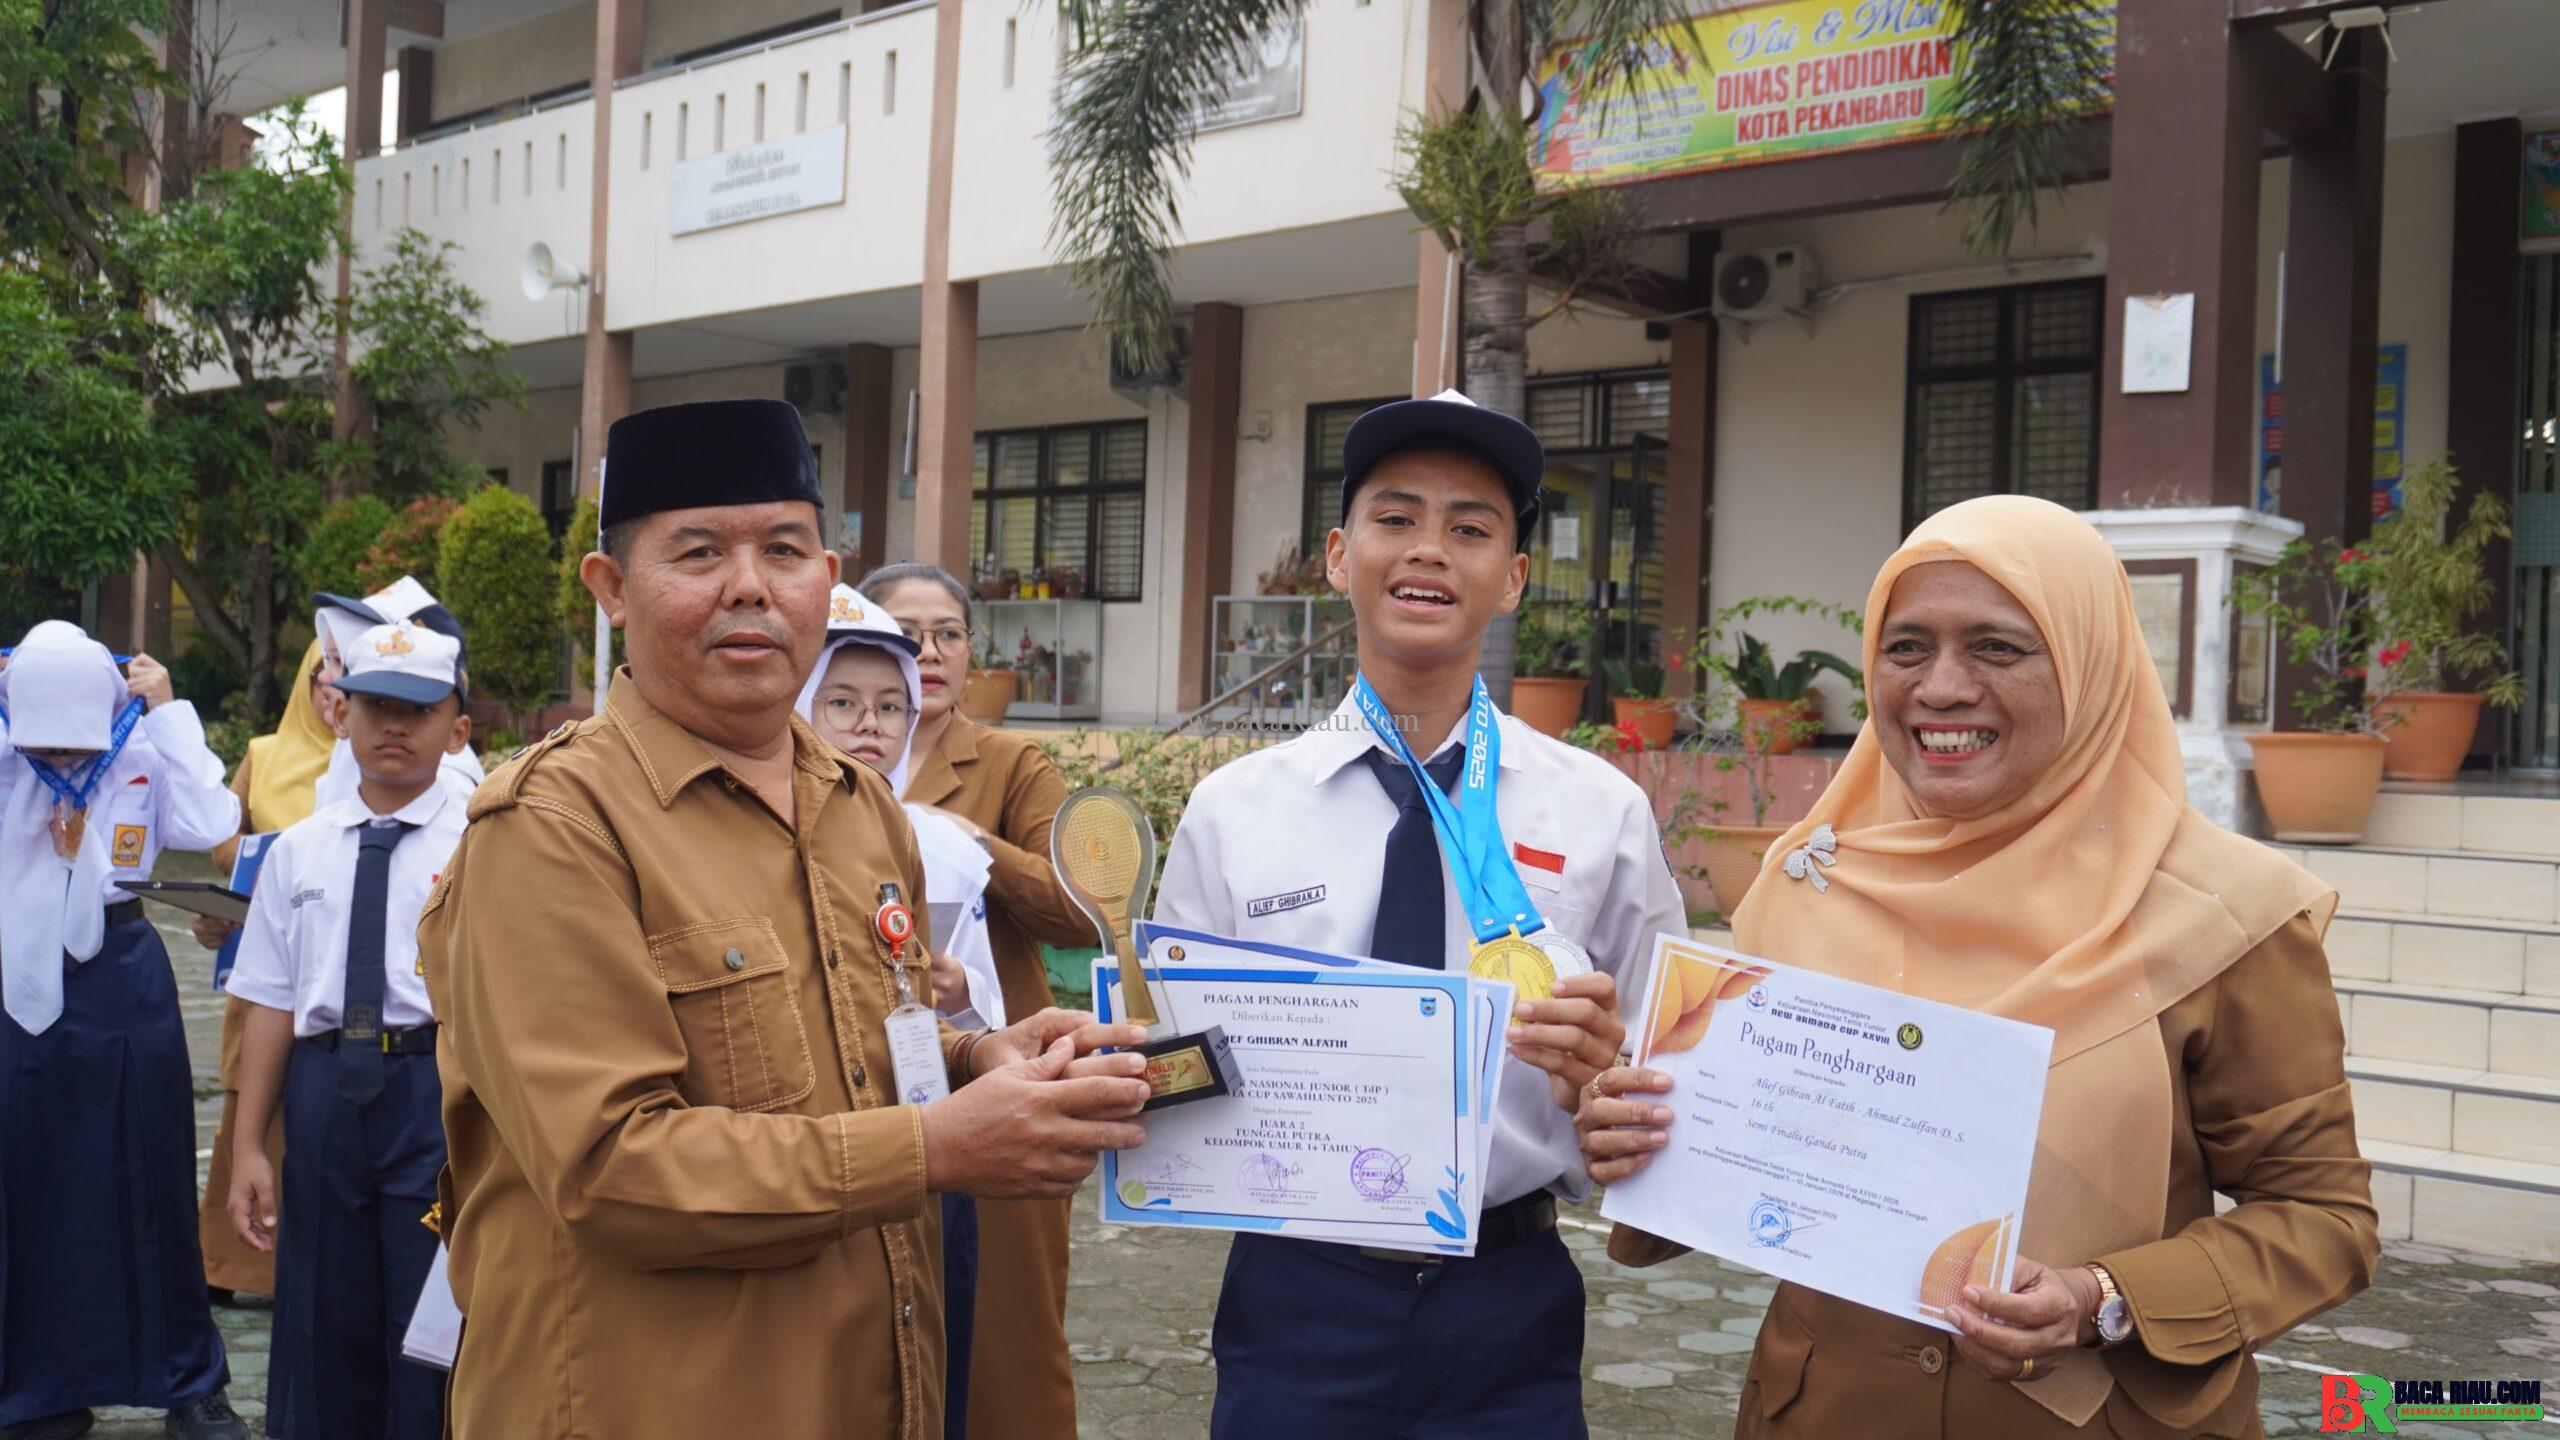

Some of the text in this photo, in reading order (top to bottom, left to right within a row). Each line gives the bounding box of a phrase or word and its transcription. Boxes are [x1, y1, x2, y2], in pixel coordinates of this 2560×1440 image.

[1728, 19, 1797, 62] Visi
[1813, 9, 1842, 44] &
[1716, 65, 1790, 112] DINAS
[1796, 39, 1951, 99] PENDIDIKAN
[1737, 110, 1790, 144] KOTA
[1794, 87, 1925, 135] PEKANBARU
[1468, 729, 1489, 790] 2025
[1253, 900, 1274, 914] ALIEF
[1204, 994, 1360, 1009] PIAGAM PENGHARGAAN
[1231, 1010, 1283, 1022] Diberikan
[1286, 1012, 1324, 1025] Kepada
[1812, 1009, 1842, 1021] Nasional
[1247, 1035, 1299, 1046] GHIBRAN
[1301, 1038, 1349, 1048] ALFATIH
[1740, 1021, 1917, 1088] Piagam Penghargaan
[1250, 1079, 1306, 1090] NASIONAL
[1310, 1081, 1351, 1091] JUNIOR
[1248, 1090, 1271, 1100] CUP
[1273, 1091, 1353, 1103] SAWAHLUNTO
[1355, 1095, 1378, 1104] 2025
[1752, 1078, 1778, 1094] Alief
[1778, 1084, 1812, 1100] Gibran
[1862, 1107, 1900, 1125] Ahmad
[1260, 1119, 1306, 1130] JUARA 2
[1235, 1128, 1331, 1142] TUNGGAL PUTRA
[1745, 1117, 1868, 1160] Semi Finalis Ganda Putra
[1204, 1137, 1363, 1153] KELOMPOK UMUR 14 TAHUN
